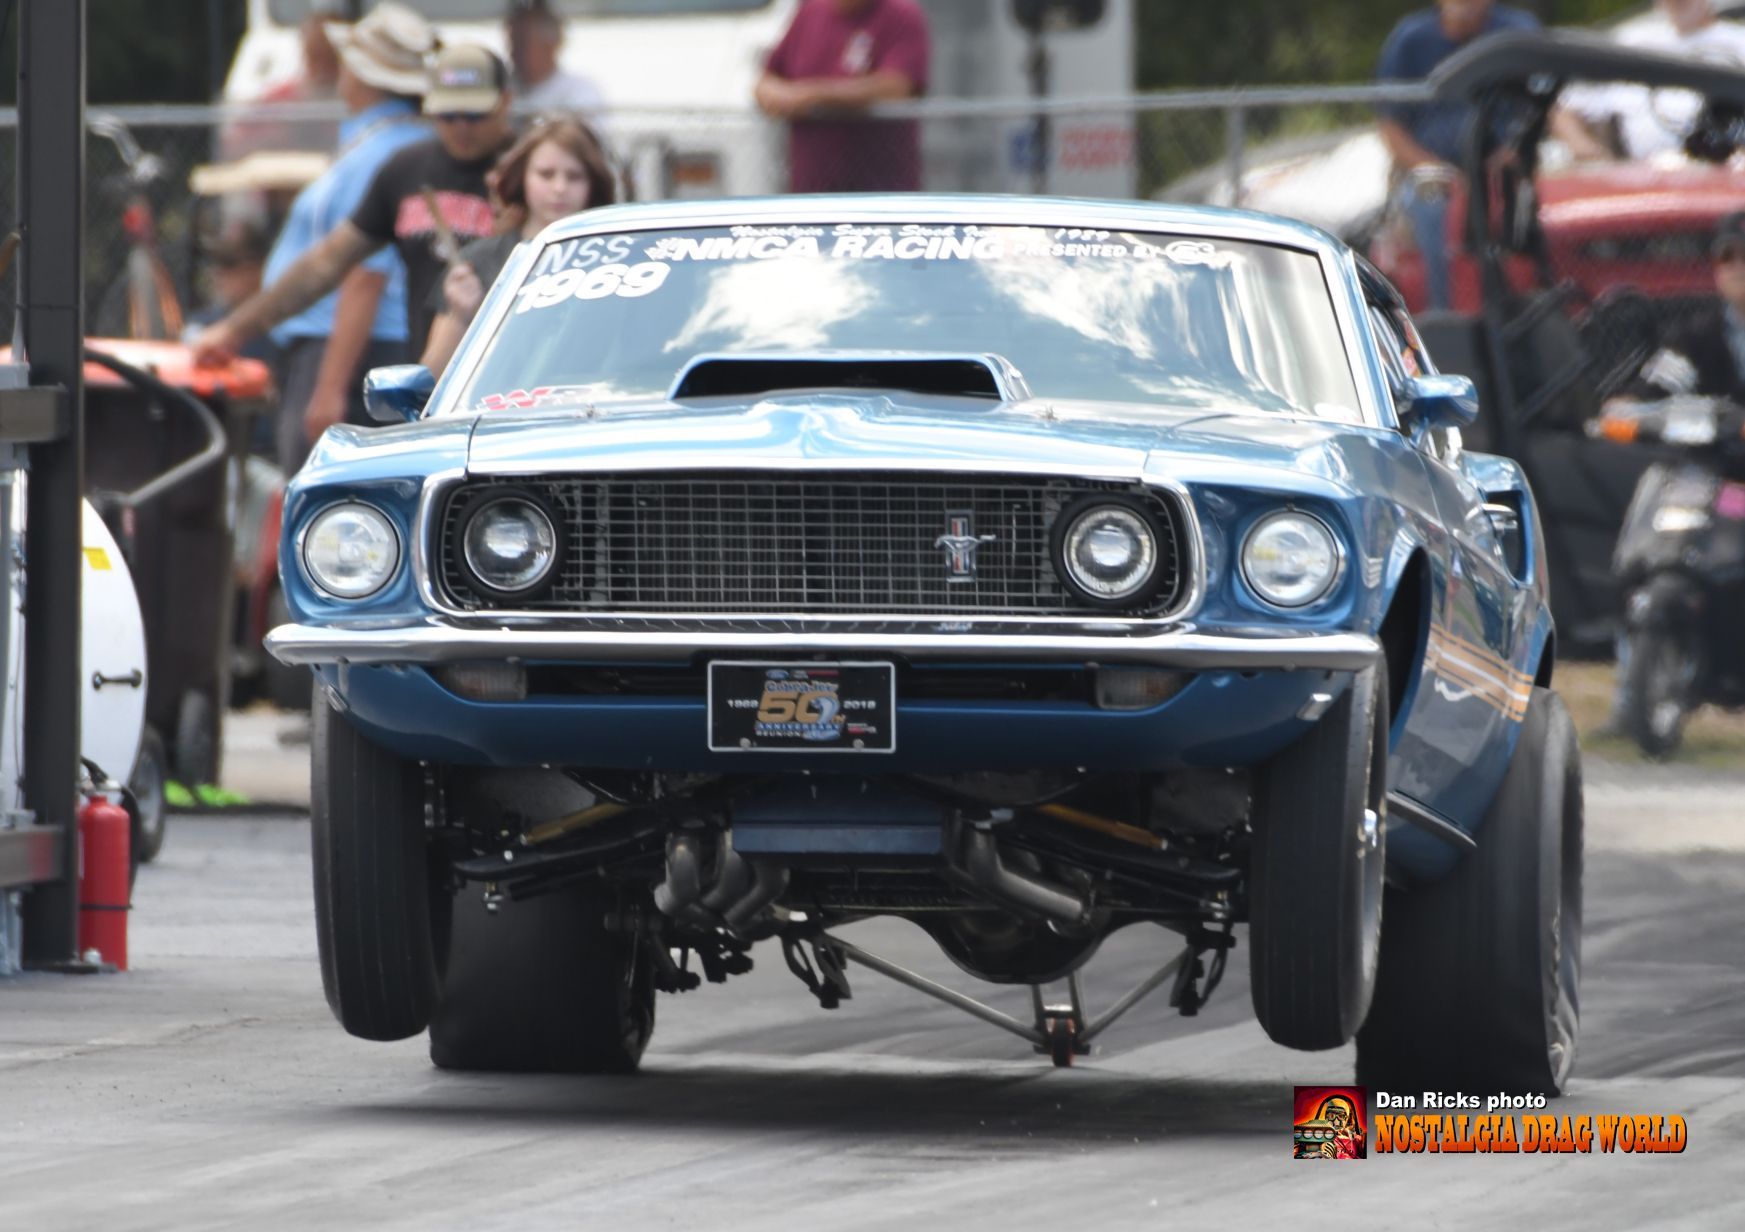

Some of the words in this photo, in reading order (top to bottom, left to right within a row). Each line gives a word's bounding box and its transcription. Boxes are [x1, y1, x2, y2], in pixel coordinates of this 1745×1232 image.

[535, 235, 635, 276] NSS
[671, 236, 821, 260] NMCA
[831, 236, 1002, 260] RACING
[1013, 242, 1128, 258] PRESENTED
[1132, 245, 1159, 259] BY
[515, 261, 671, 315] 1969
[757, 690, 840, 724] 50
[843, 700, 876, 709] 2018
[756, 723, 841, 731] ANNIVERSARY
